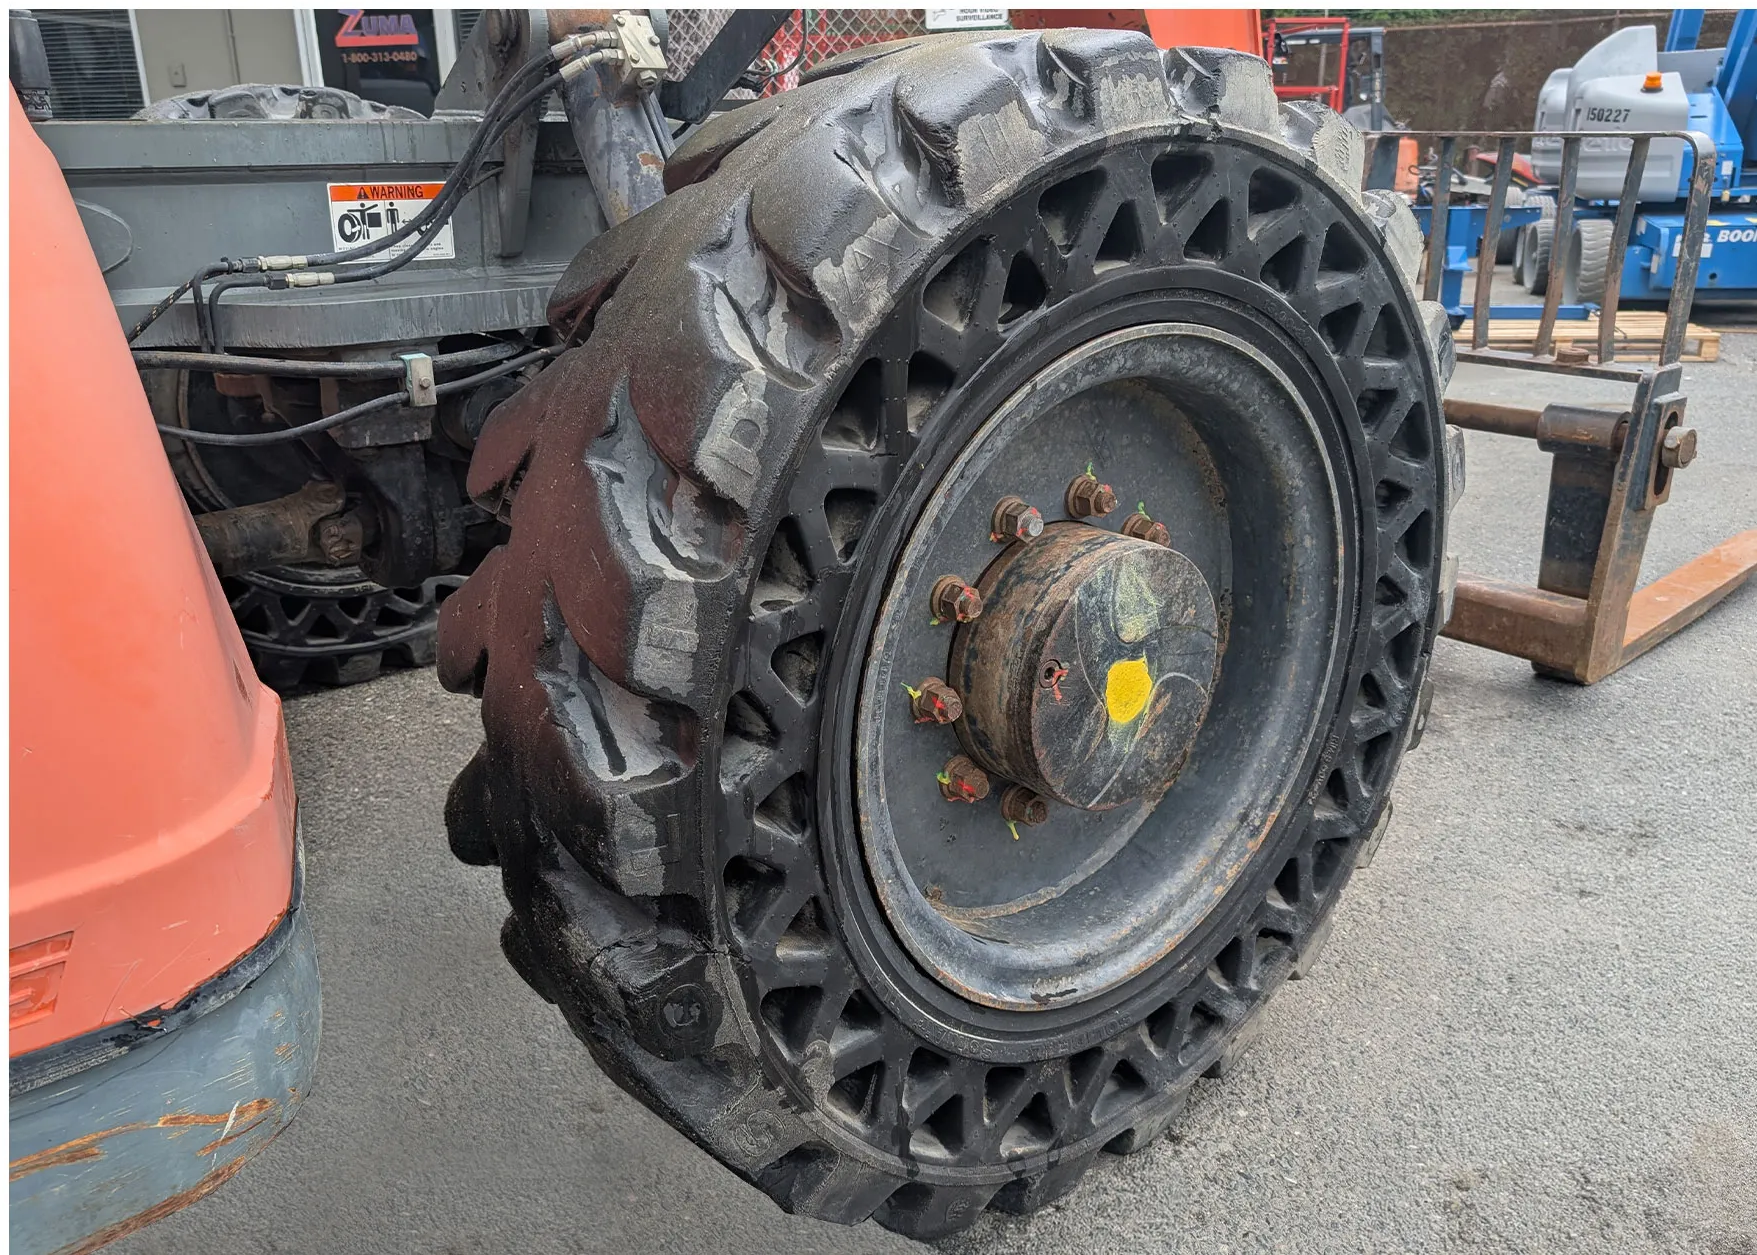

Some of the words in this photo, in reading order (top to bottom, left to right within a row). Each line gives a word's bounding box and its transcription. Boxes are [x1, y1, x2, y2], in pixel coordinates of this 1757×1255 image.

[335, 9, 419, 47] ZUMA
[1586, 107, 1631, 123] 150227
[370, 185, 424, 200] WARNING
